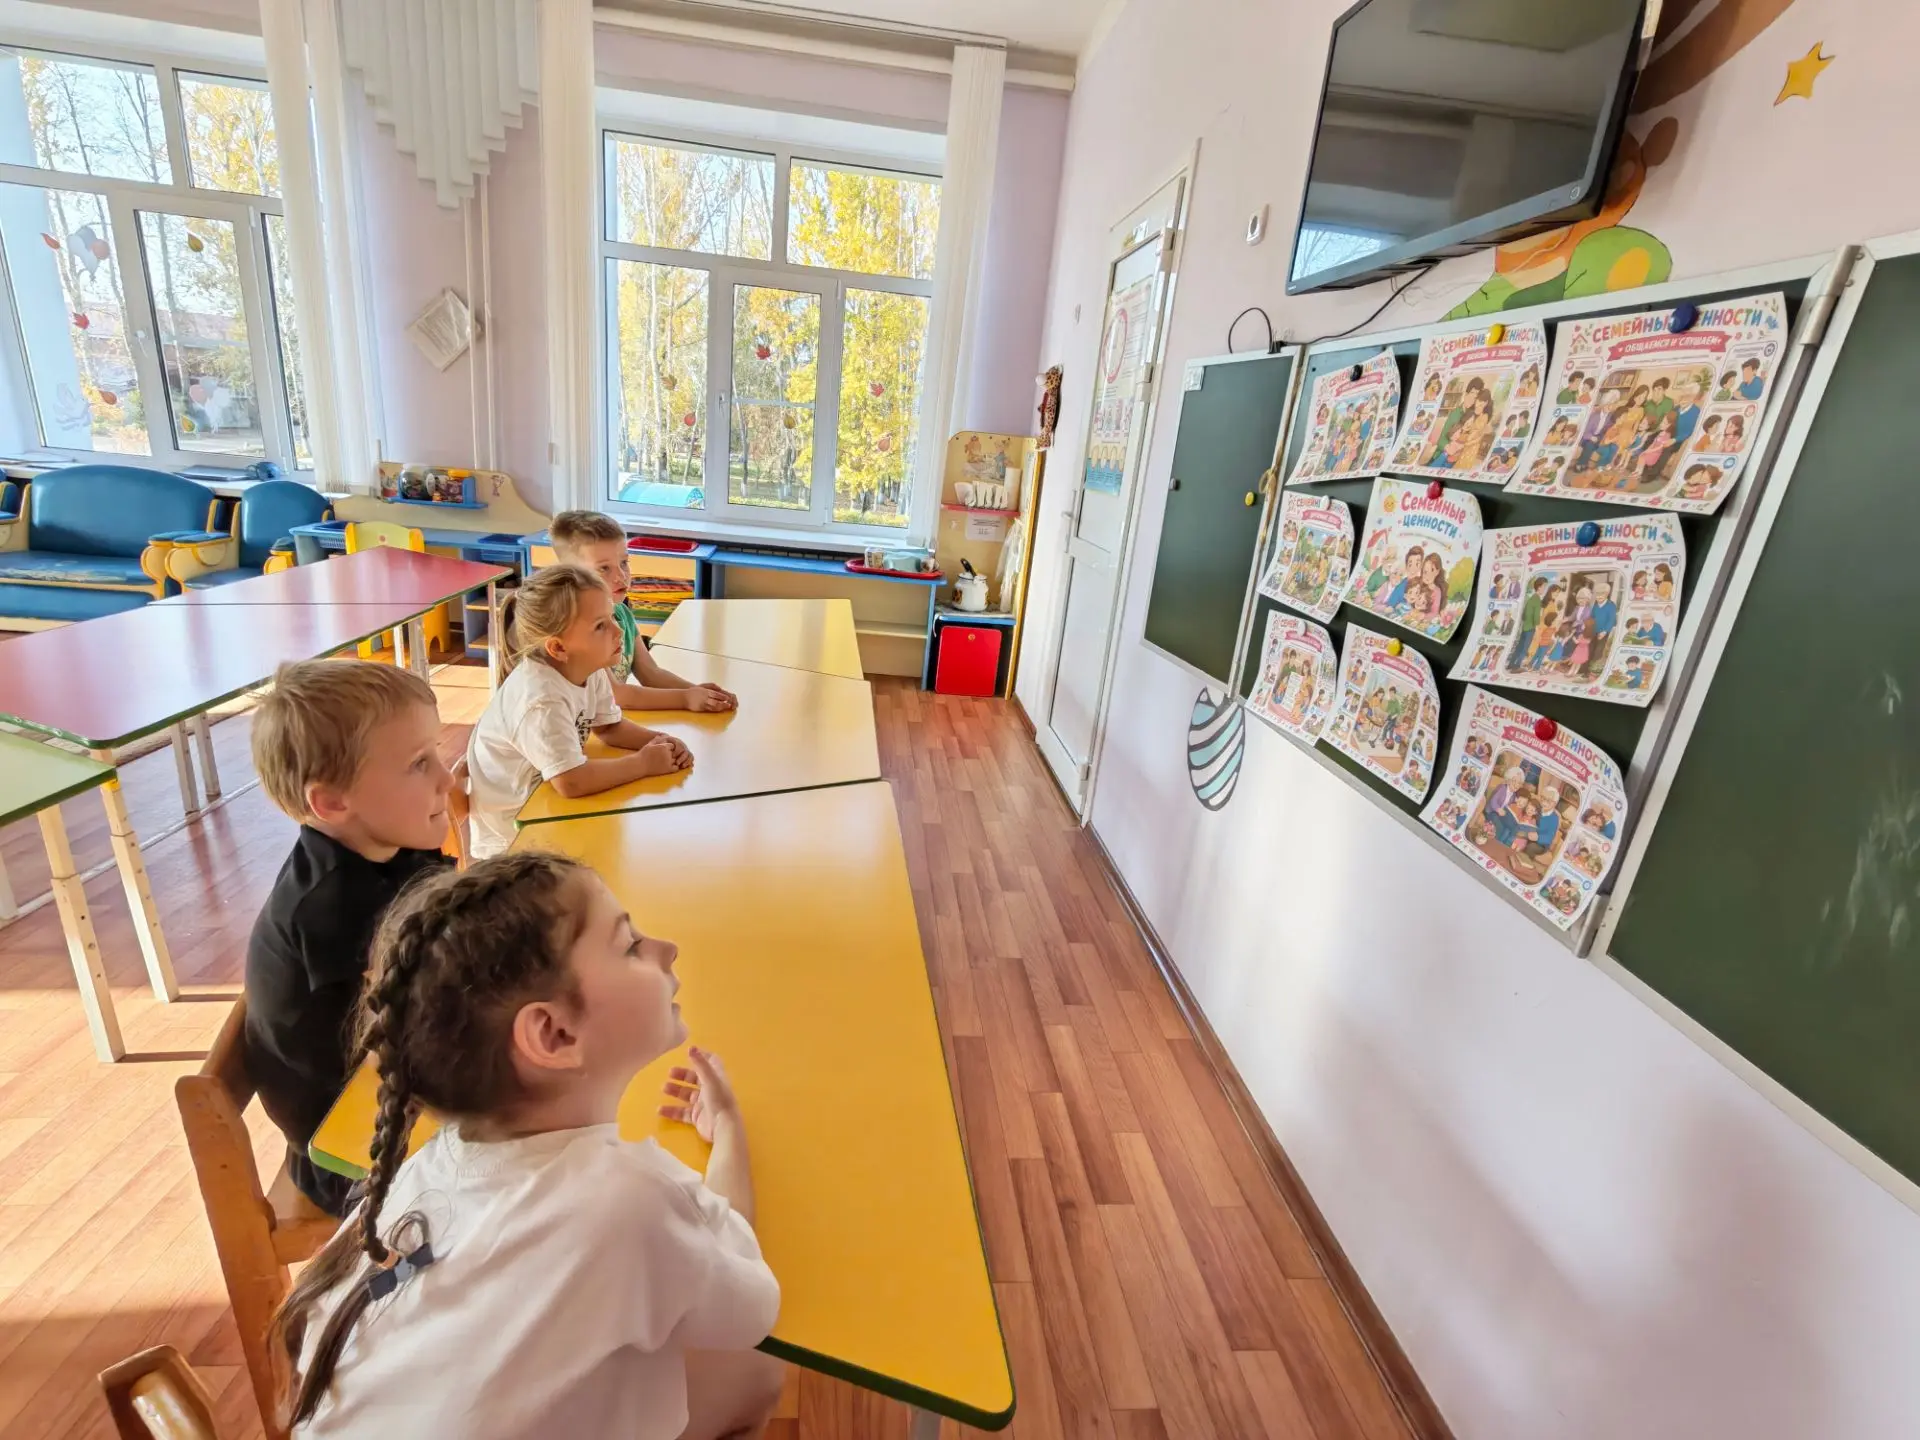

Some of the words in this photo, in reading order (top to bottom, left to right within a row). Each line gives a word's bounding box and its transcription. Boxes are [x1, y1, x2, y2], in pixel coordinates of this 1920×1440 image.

[1403, 514, 1459, 539] ценности
[1513, 527, 1577, 549] СЕМЕЙНЫ
[1492, 705, 1537, 729] СЕМЕЙН
